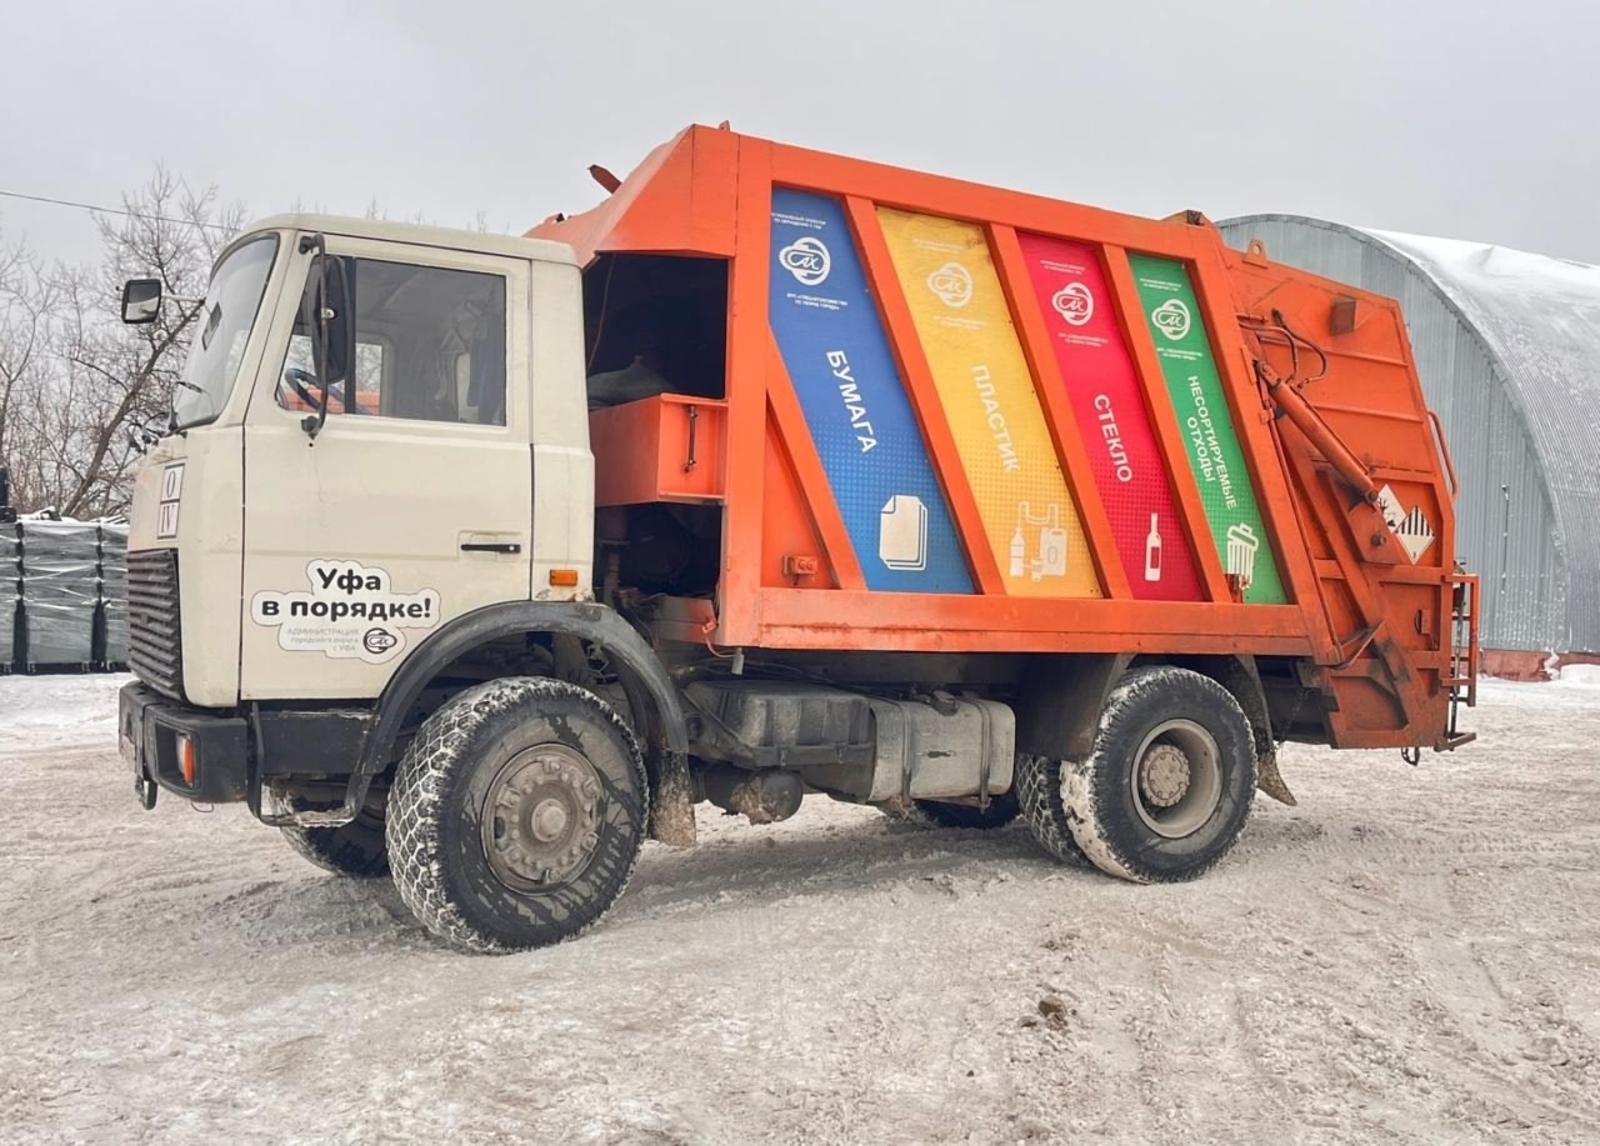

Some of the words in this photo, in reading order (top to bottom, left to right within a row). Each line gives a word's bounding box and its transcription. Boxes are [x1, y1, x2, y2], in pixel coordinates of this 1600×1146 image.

[826, 350, 877, 453] БУМАГА
[970, 364, 1021, 473] ПЛАСТИК
[1094, 394, 1133, 482] СТЕКЛО
[1187, 375, 1237, 510] НЕСОРТИРУЕМЫЕ
[1187, 416, 1215, 482] ОТХОДЫ
[262, 600, 279, 616] в
[290, 597, 431, 622] порядке!
[316, 567, 381, 595] Уфа
